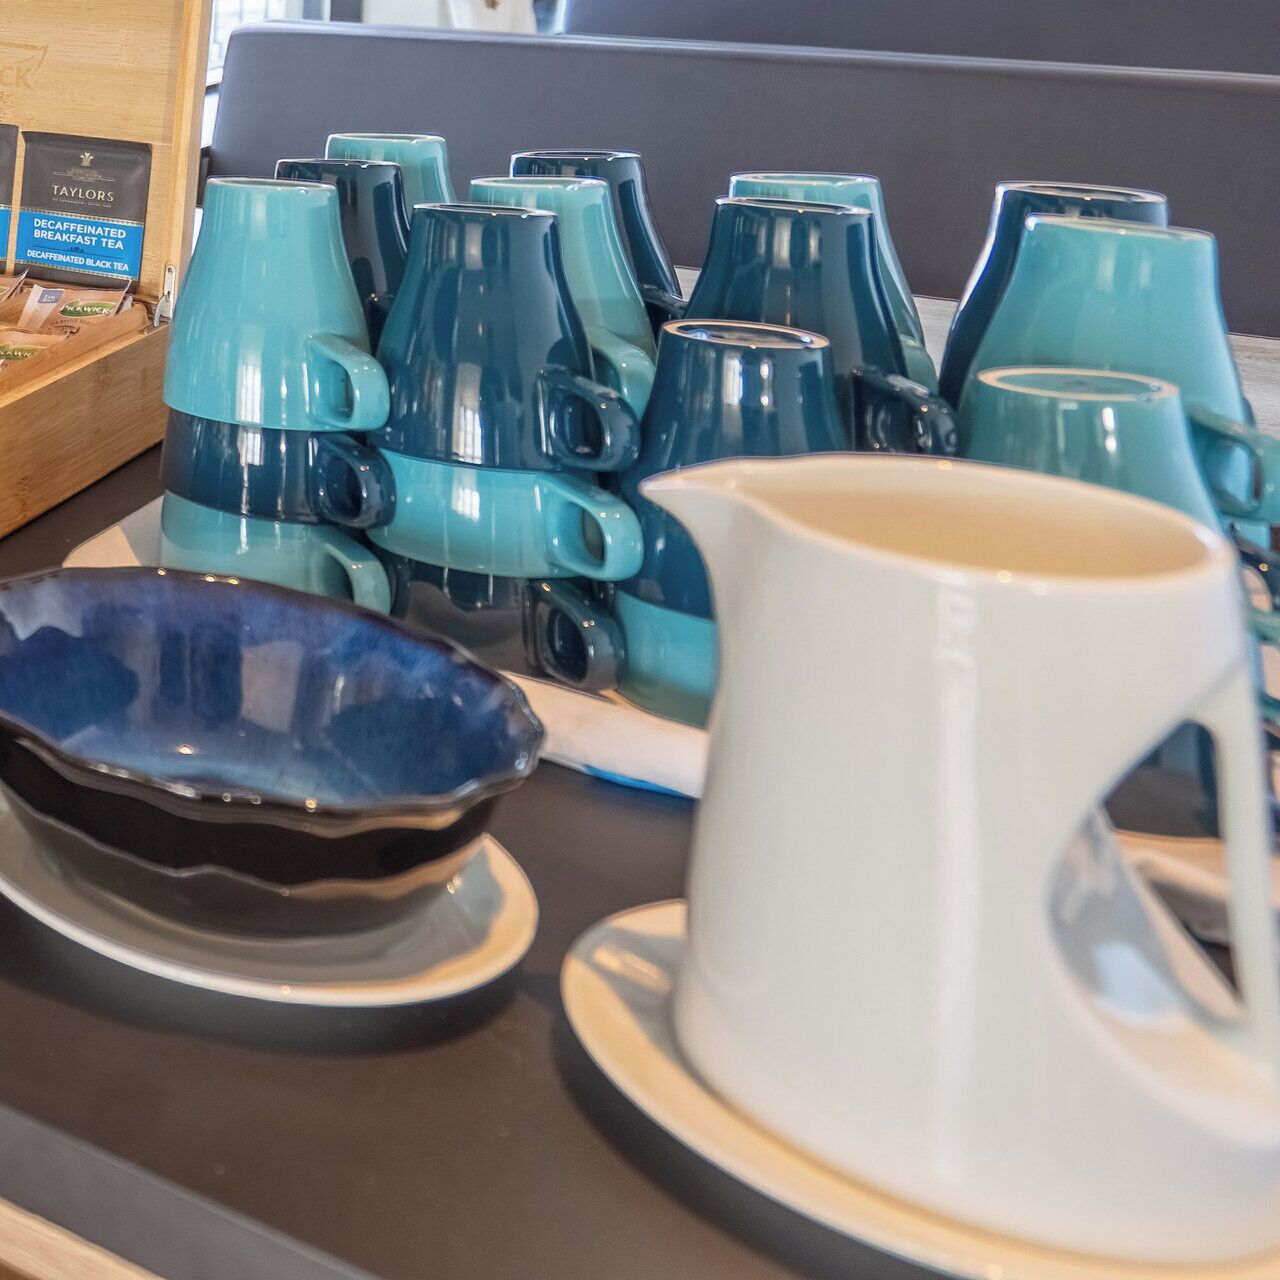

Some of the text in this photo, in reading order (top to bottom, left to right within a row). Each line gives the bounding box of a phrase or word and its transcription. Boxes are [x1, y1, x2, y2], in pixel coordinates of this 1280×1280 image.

[52, 184, 115, 202] TAYLORS
[34, 218, 126, 239] DECAFFEINATED
[34, 229, 124, 250] BREAKFAST TEA
[27, 249, 129, 272] DECAFFEINATED BLACK TEA
